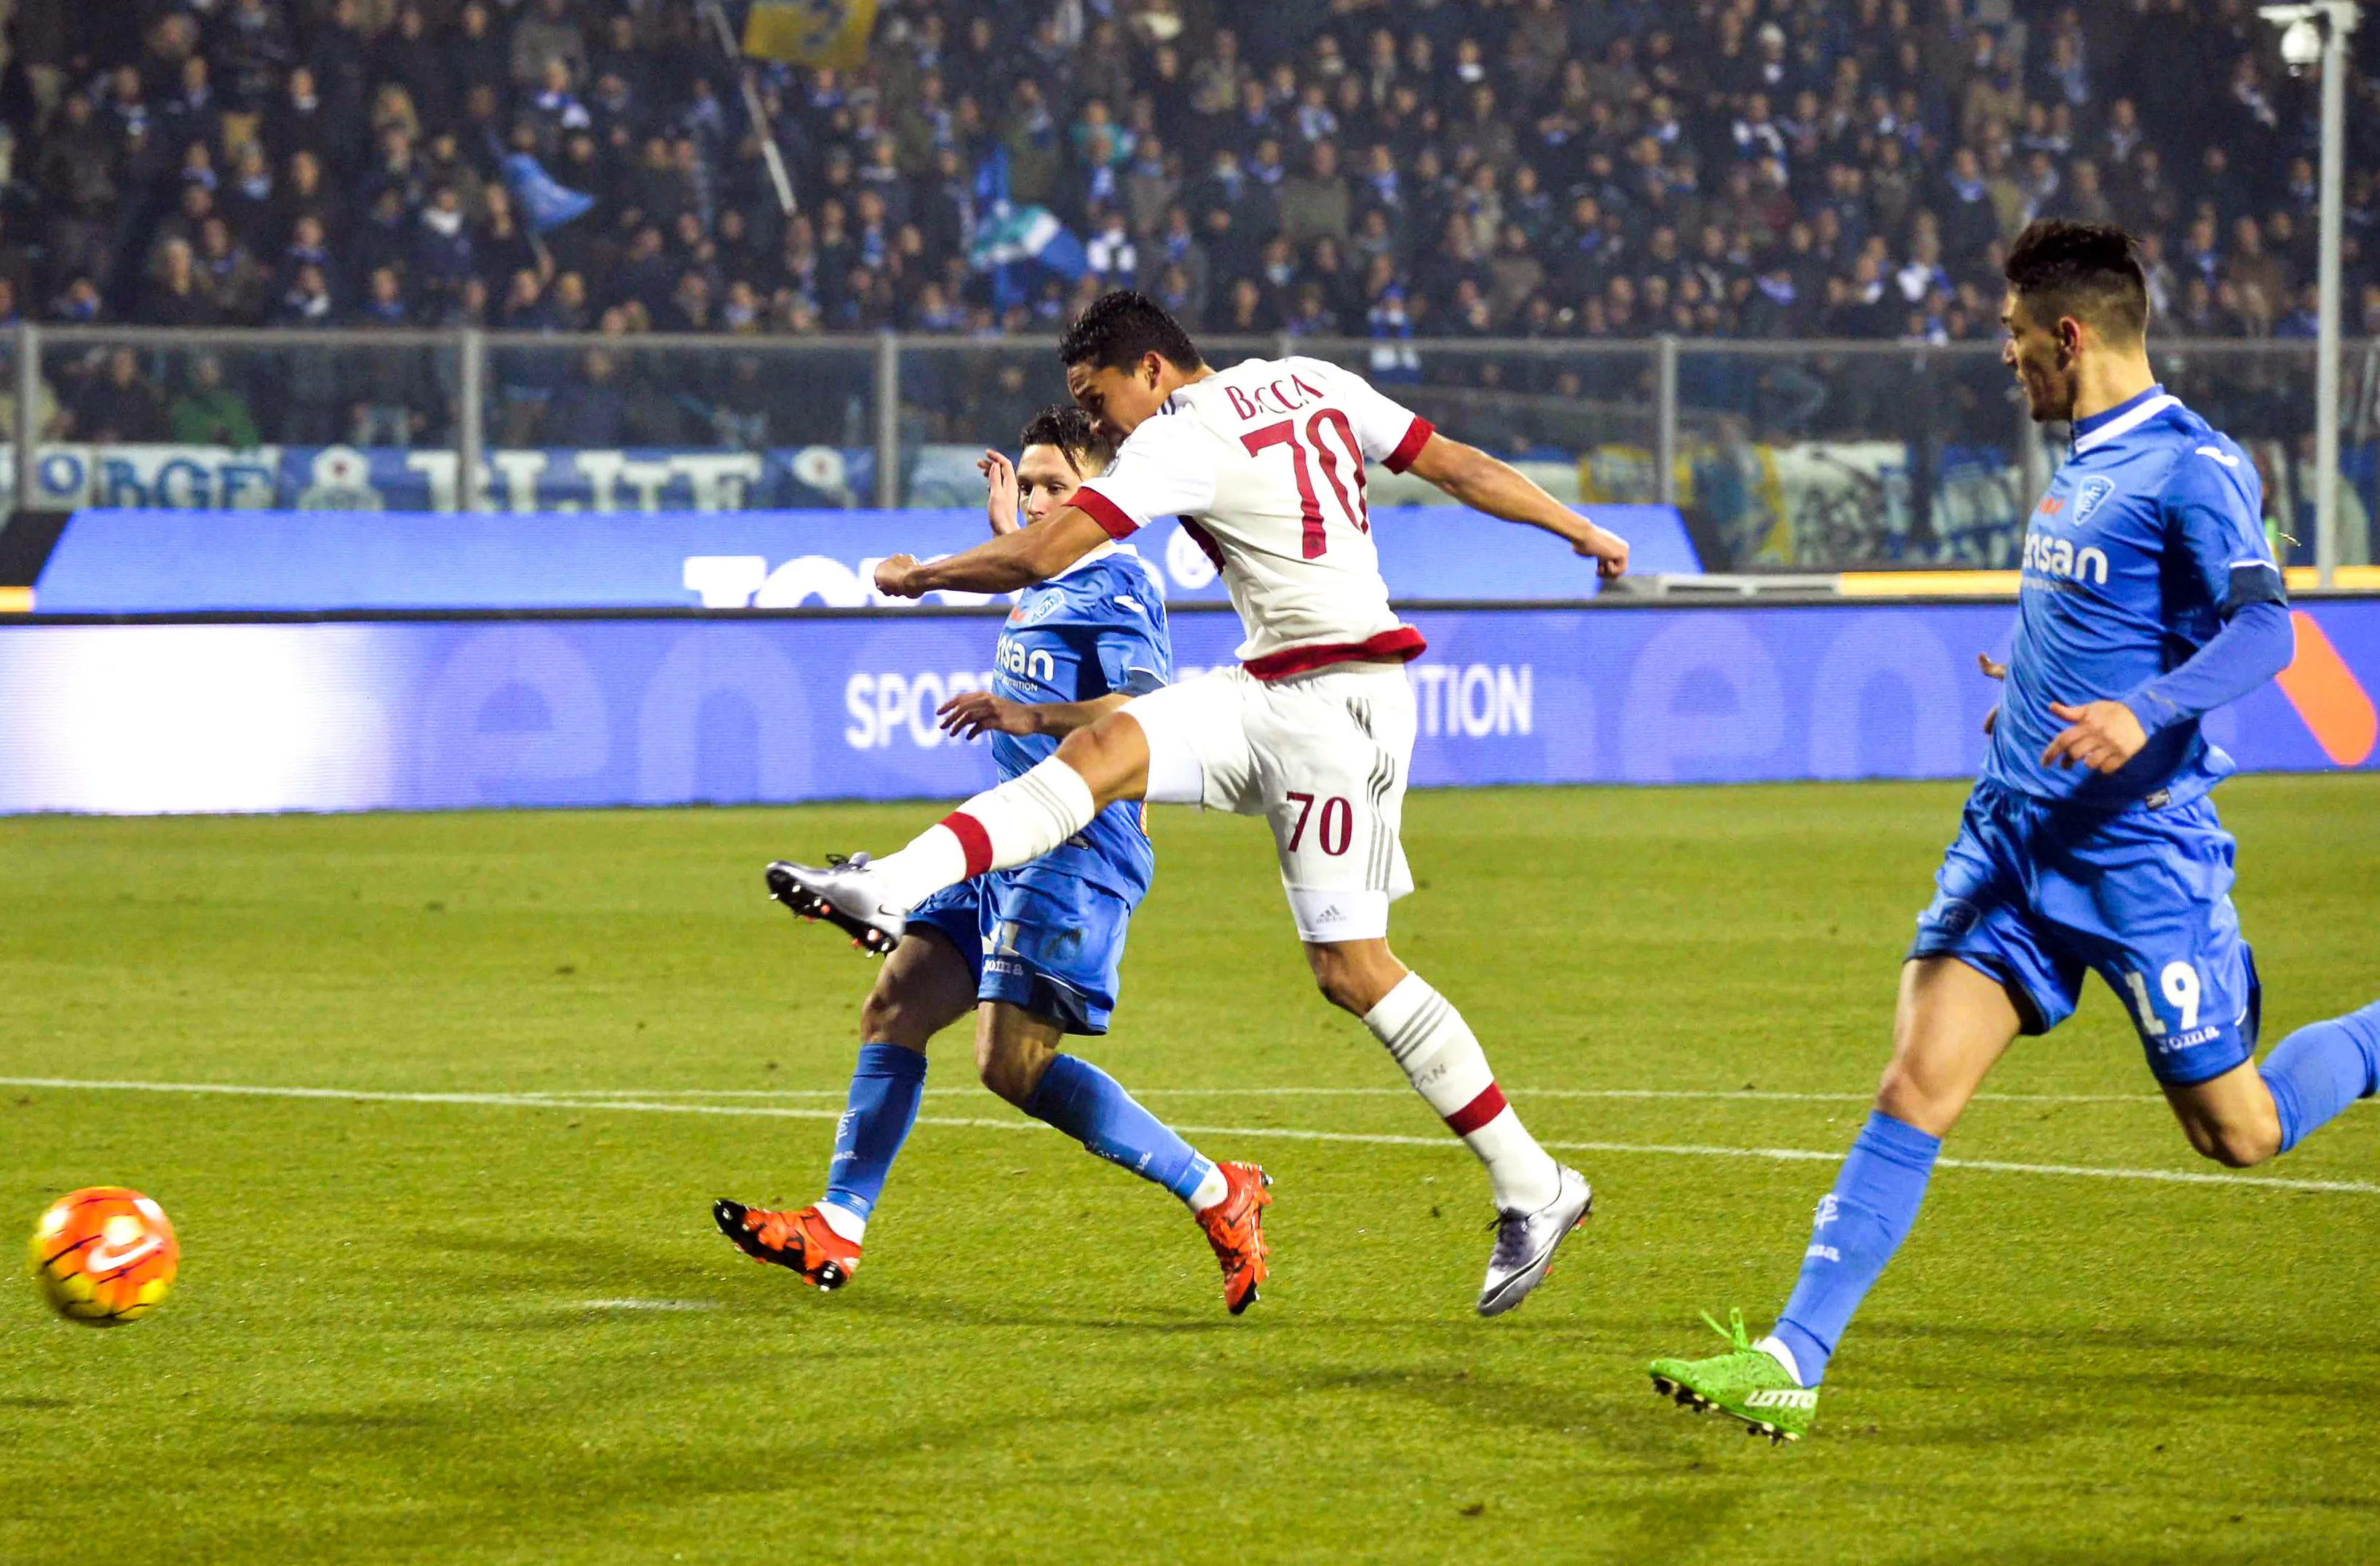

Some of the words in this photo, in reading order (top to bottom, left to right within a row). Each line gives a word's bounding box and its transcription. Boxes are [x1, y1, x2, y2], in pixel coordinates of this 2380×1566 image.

[1239, 408, 1368, 560] 70
[996, 631, 1054, 681] nsan
[1286, 790, 1353, 856] 70
[2125, 961, 2200, 1036] 19
